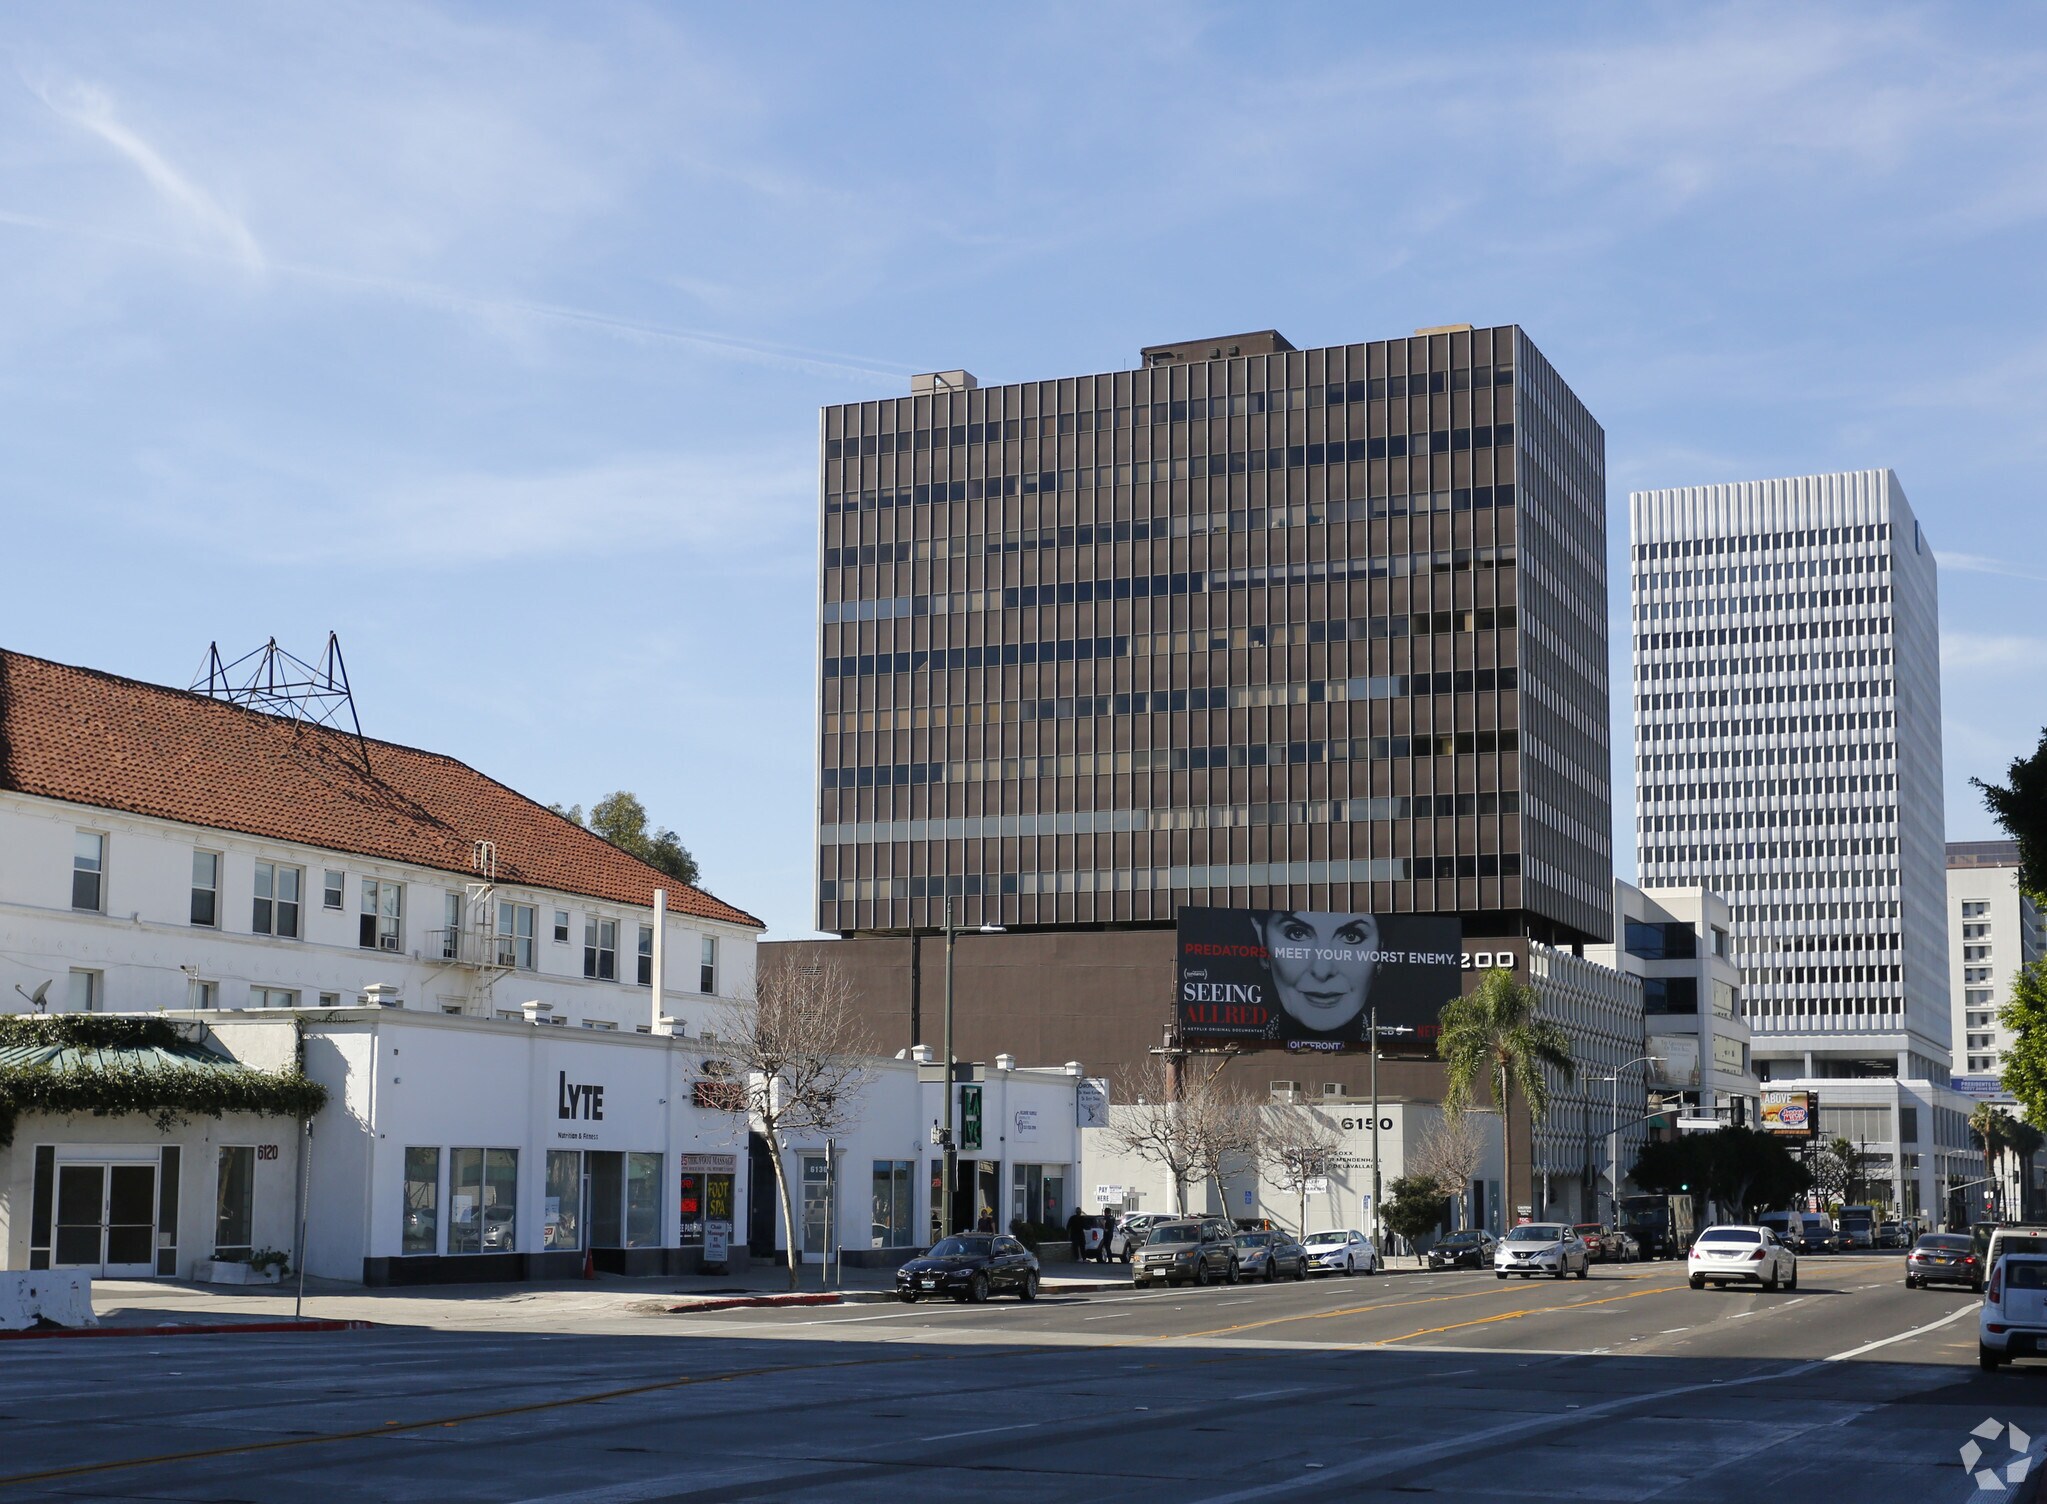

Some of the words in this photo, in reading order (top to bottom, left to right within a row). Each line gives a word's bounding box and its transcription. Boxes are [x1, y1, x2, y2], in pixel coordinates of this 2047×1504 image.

[1185, 943, 1272, 959] PREDATORS,
[1274, 947, 1311, 960] MEET
[1314, 949, 1352, 962] YOUR
[1356, 950, 1406, 964] WORST
[1409, 952, 1457, 966] ENEMY.
[1183, 982, 1262, 1004] SEEING
[1185, 1003, 1268, 1025] ALLRED
[1765, 1093, 1792, 1104] ABOVE
[1341, 1117, 1394, 1130] 6150
[257, 1144, 279, 1161] 6120
[708, 1181, 729, 1198] FOOT
[710, 1199, 726, 1216] SPA
